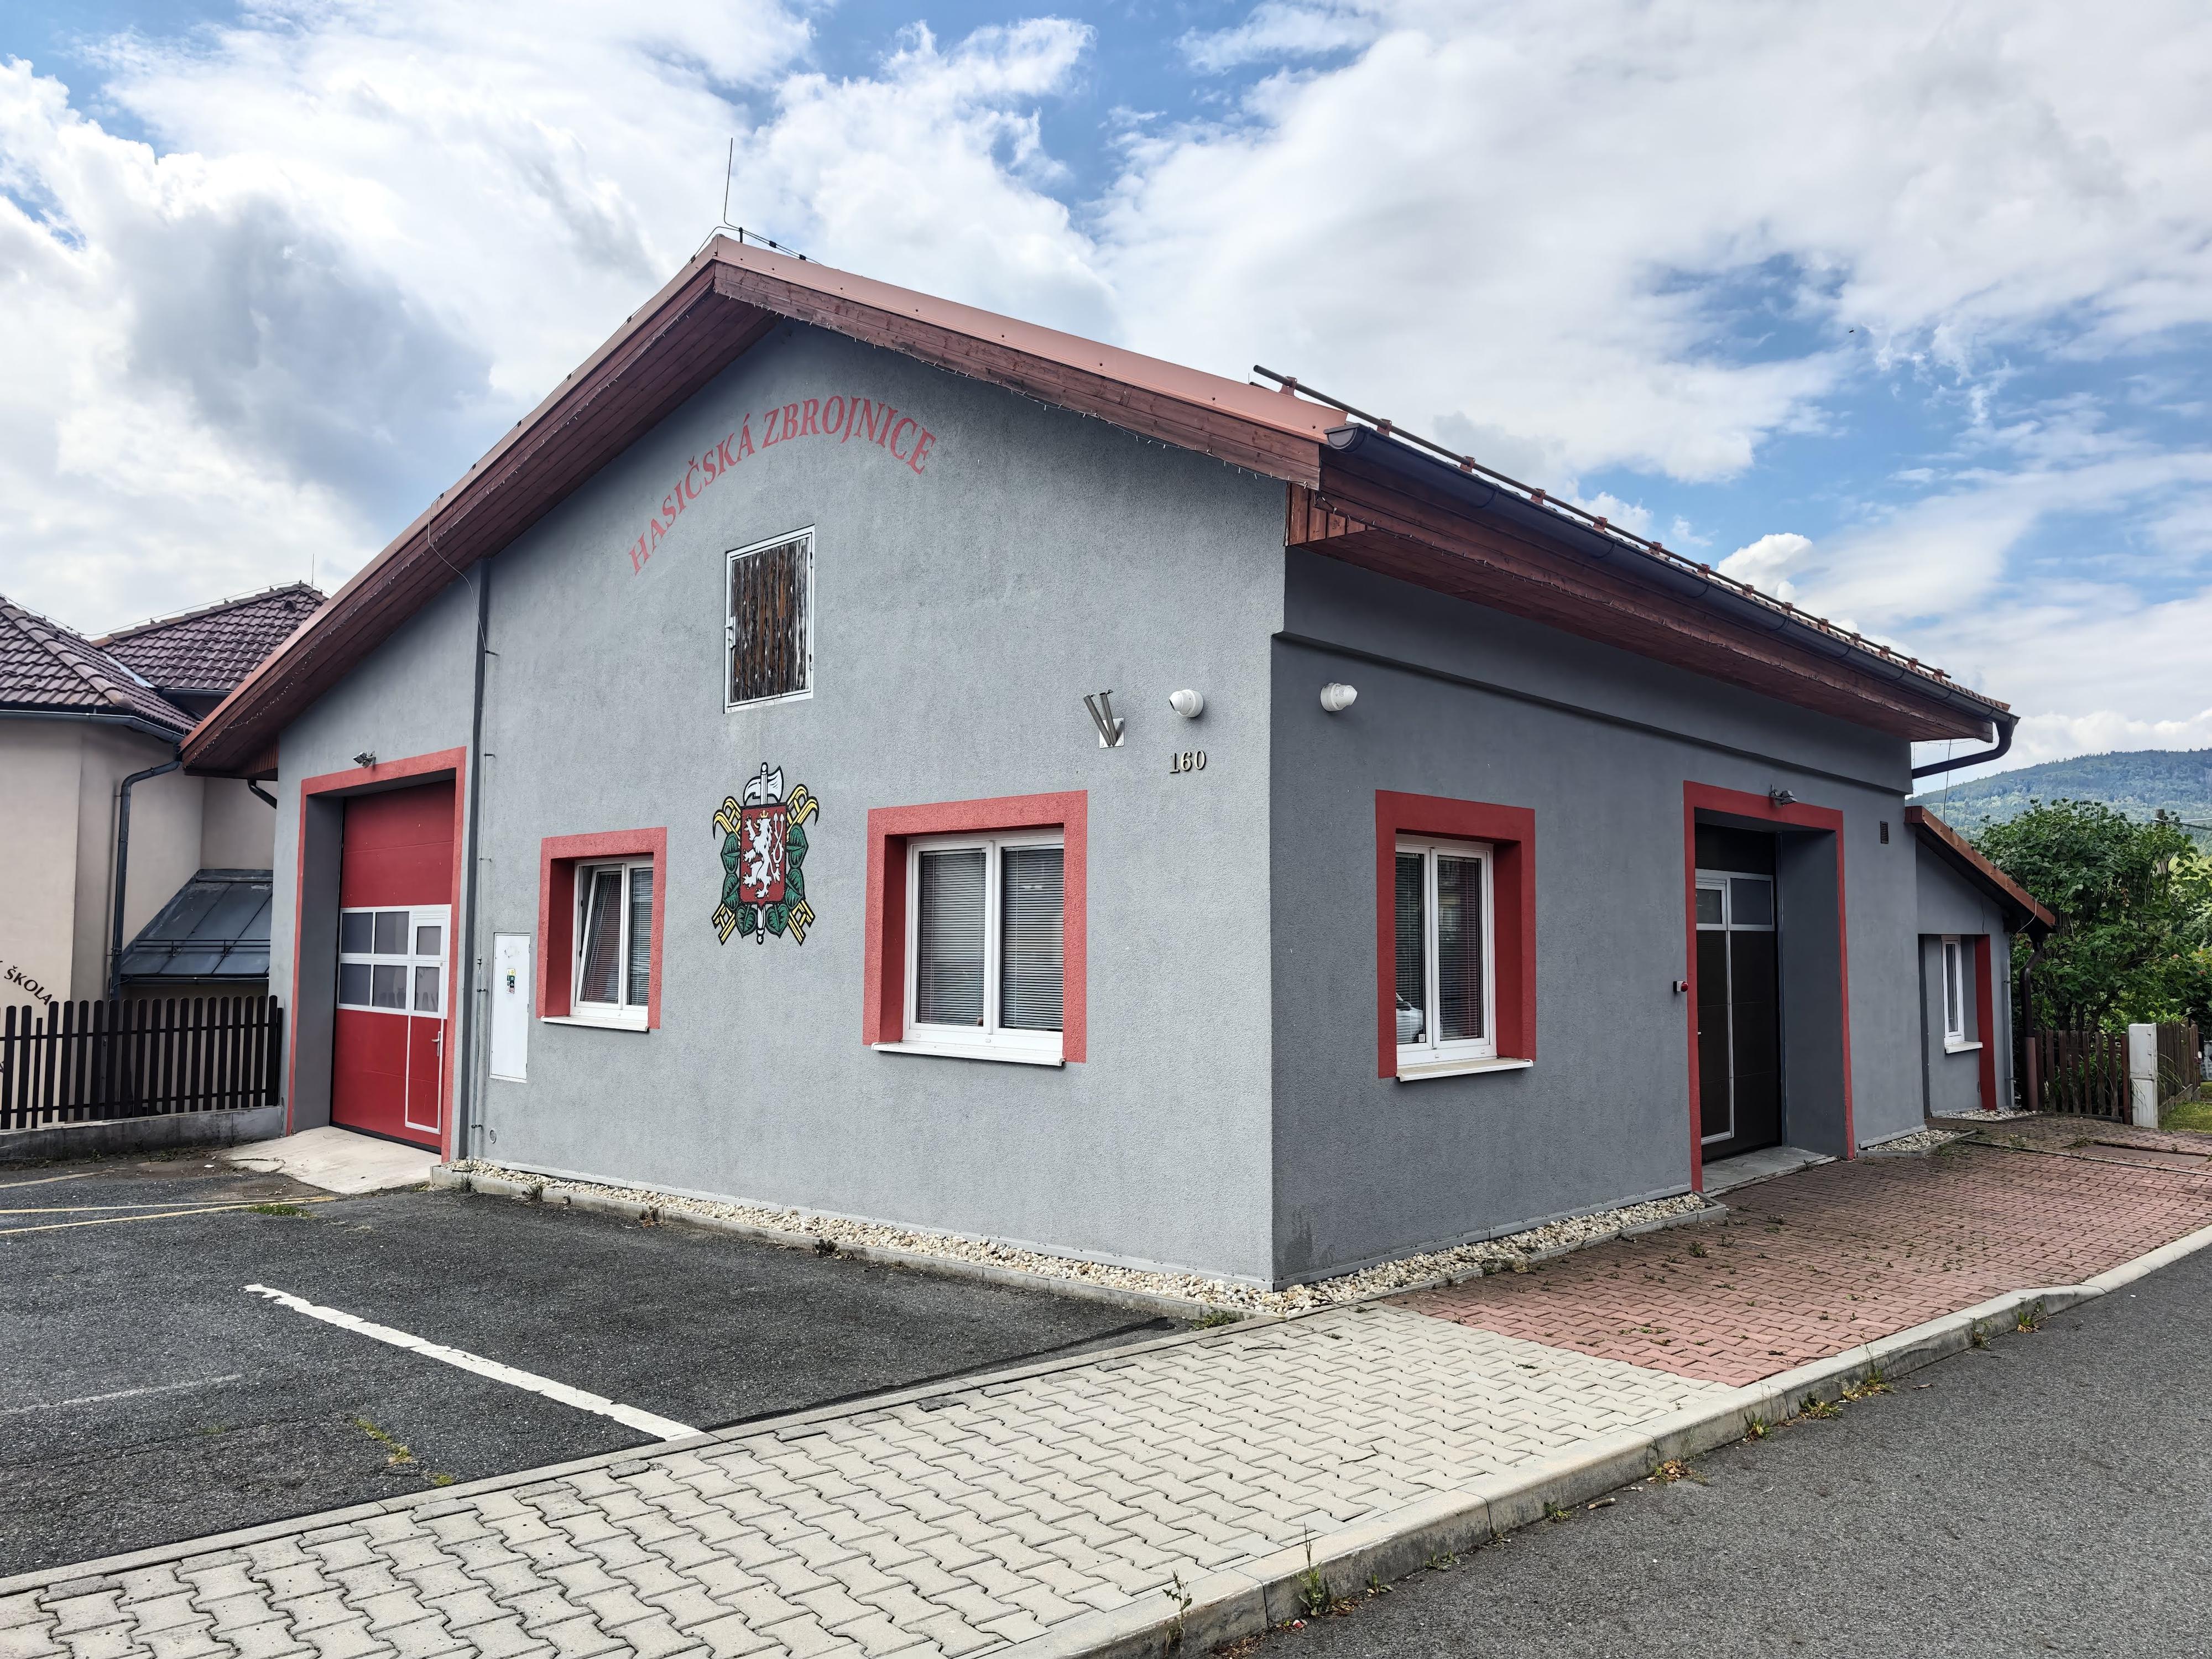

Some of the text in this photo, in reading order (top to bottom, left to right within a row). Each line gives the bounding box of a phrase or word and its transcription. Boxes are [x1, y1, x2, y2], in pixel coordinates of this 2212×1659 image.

[628, 395, 937, 576] HASIČSKÁ ZBROJNICE
[1169, 750, 1207, 774] 160
[4, 965, 53, 1005] ŠKOLA
